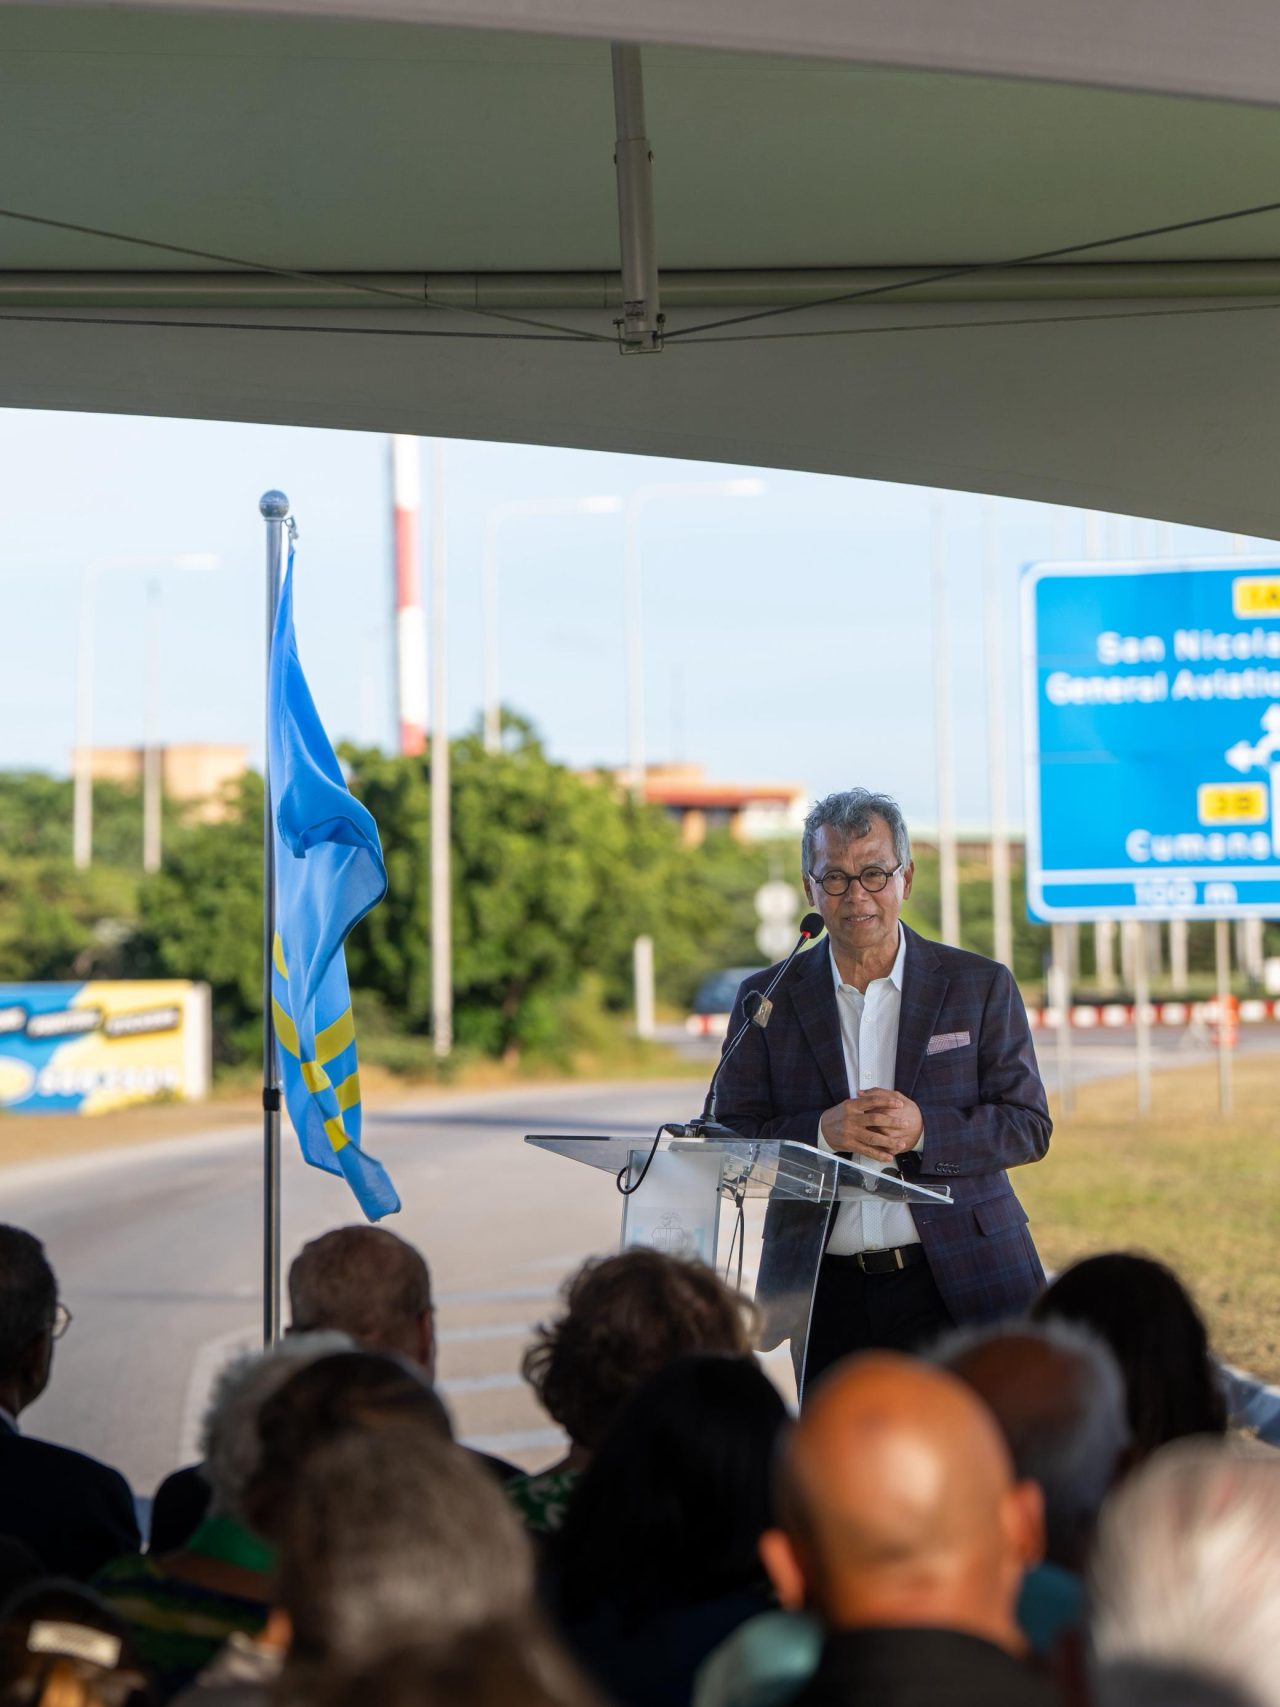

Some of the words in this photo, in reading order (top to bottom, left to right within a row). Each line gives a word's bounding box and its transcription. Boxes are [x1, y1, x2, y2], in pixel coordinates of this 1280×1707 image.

[1098, 632, 1164, 664] San
[1046, 672, 1167, 705] General
[1126, 830, 1270, 863] Cumana
